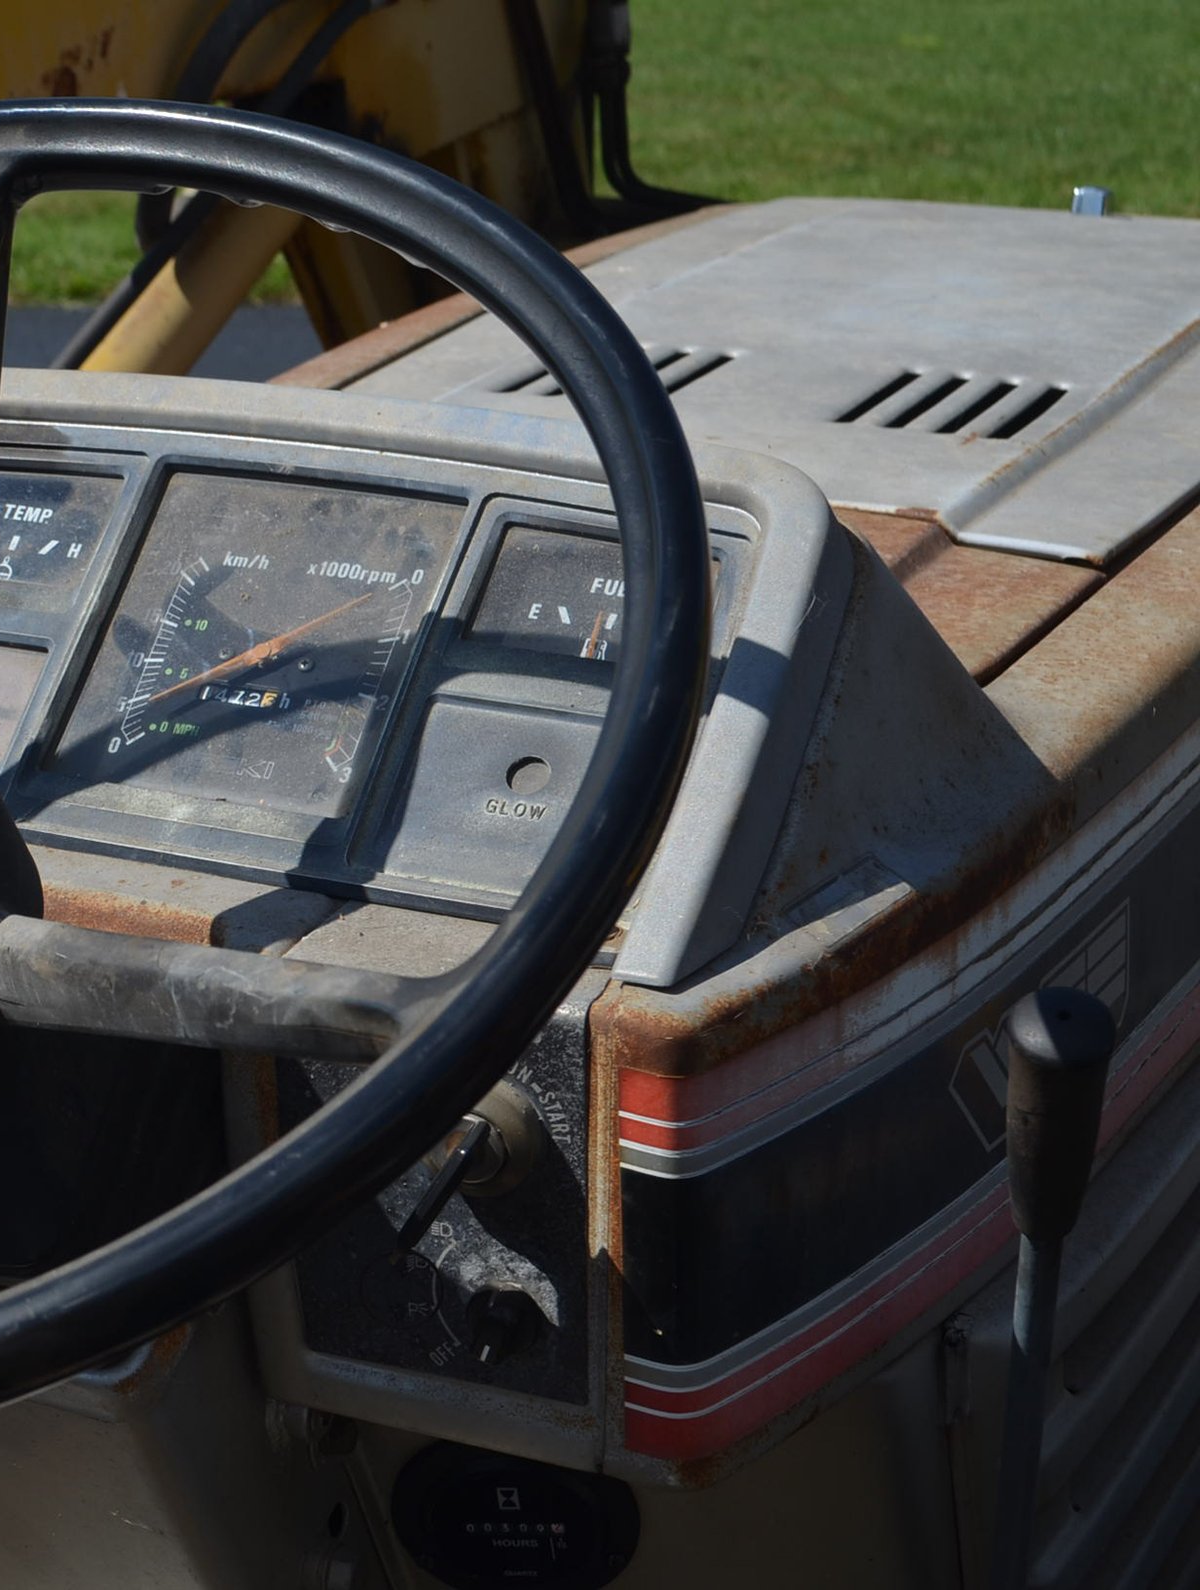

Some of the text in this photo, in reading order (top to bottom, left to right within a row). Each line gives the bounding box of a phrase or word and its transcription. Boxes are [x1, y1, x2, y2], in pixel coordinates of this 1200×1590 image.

[3, 503, 54, 525] TEMP.
[66, 542, 83, 560] H
[222, 551, 270, 571] km/h
[306, 561, 398, 585] x1000rpm
[411, 569, 425, 585] 0
[589, 577, 627, 598] FU
[527, 602, 543, 620] E
[194, 619, 209, 632] 10
[127, 649, 145, 668] 10
[179, 667, 190, 679] 5
[116, 695, 129, 712] 5
[375, 695, 390, 711] 2
[172, 722, 200, 737] MPH
[108, 737, 122, 754] 0
[338, 767, 353, 784] 3
[484, 798, 548, 821] GLOW
[428, 1339, 457, 1367] OFF
[491, 1538, 540, 1548] HOURS
